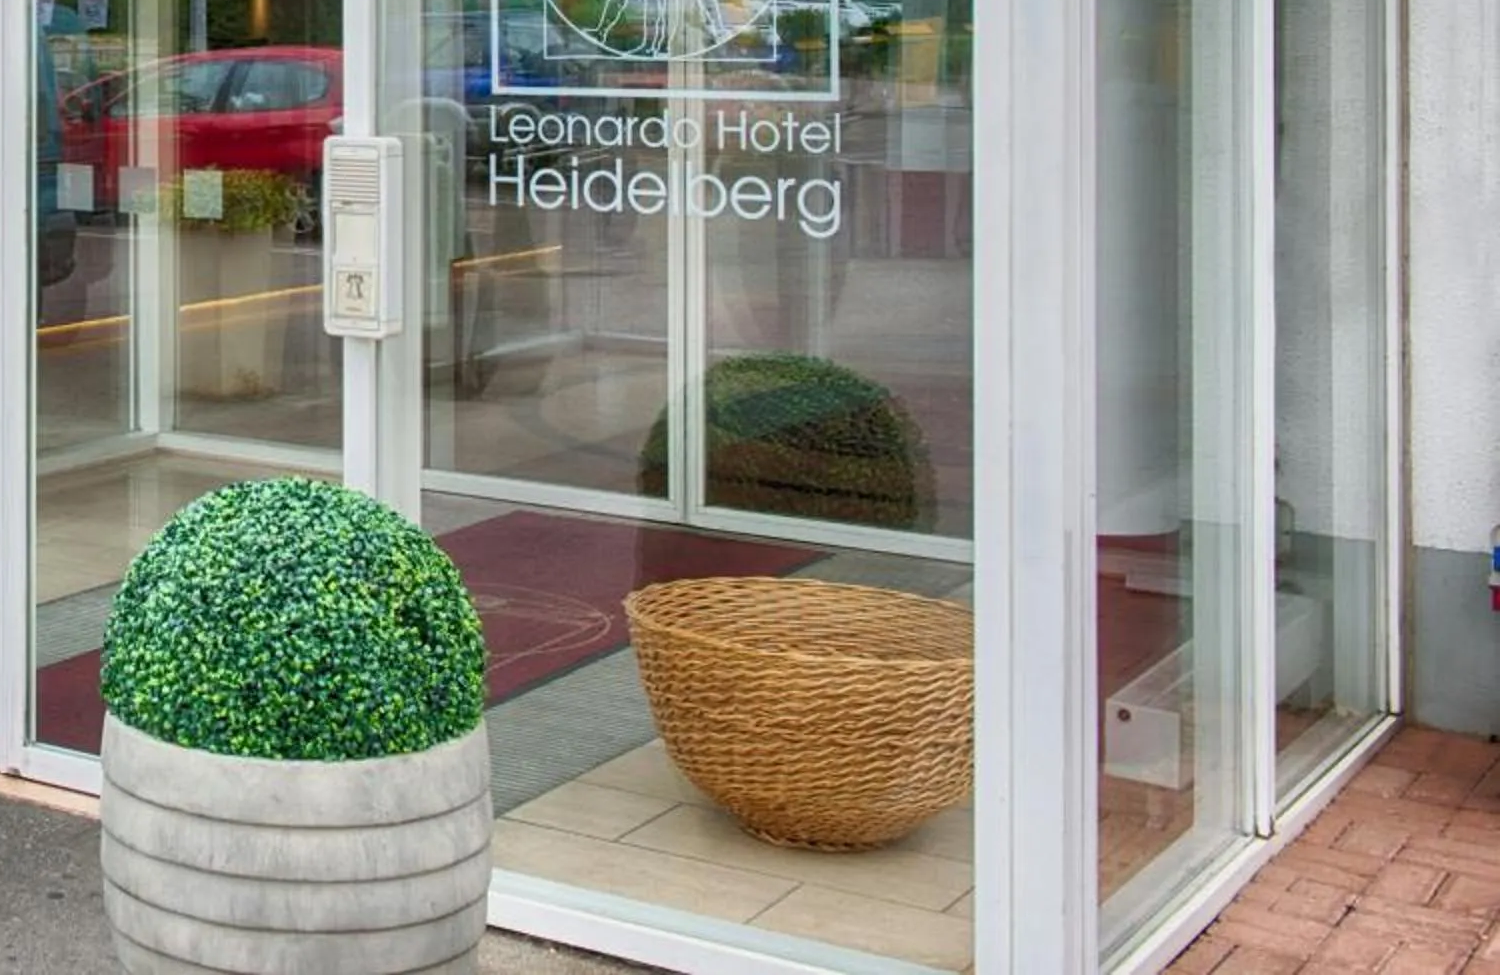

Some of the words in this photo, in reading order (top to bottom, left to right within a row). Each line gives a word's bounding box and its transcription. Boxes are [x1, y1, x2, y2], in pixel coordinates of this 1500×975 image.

[490, 104, 701, 149] Leonardo
[717, 109, 841, 154] Hotel
[489, 152, 842, 239] Heidelberg
